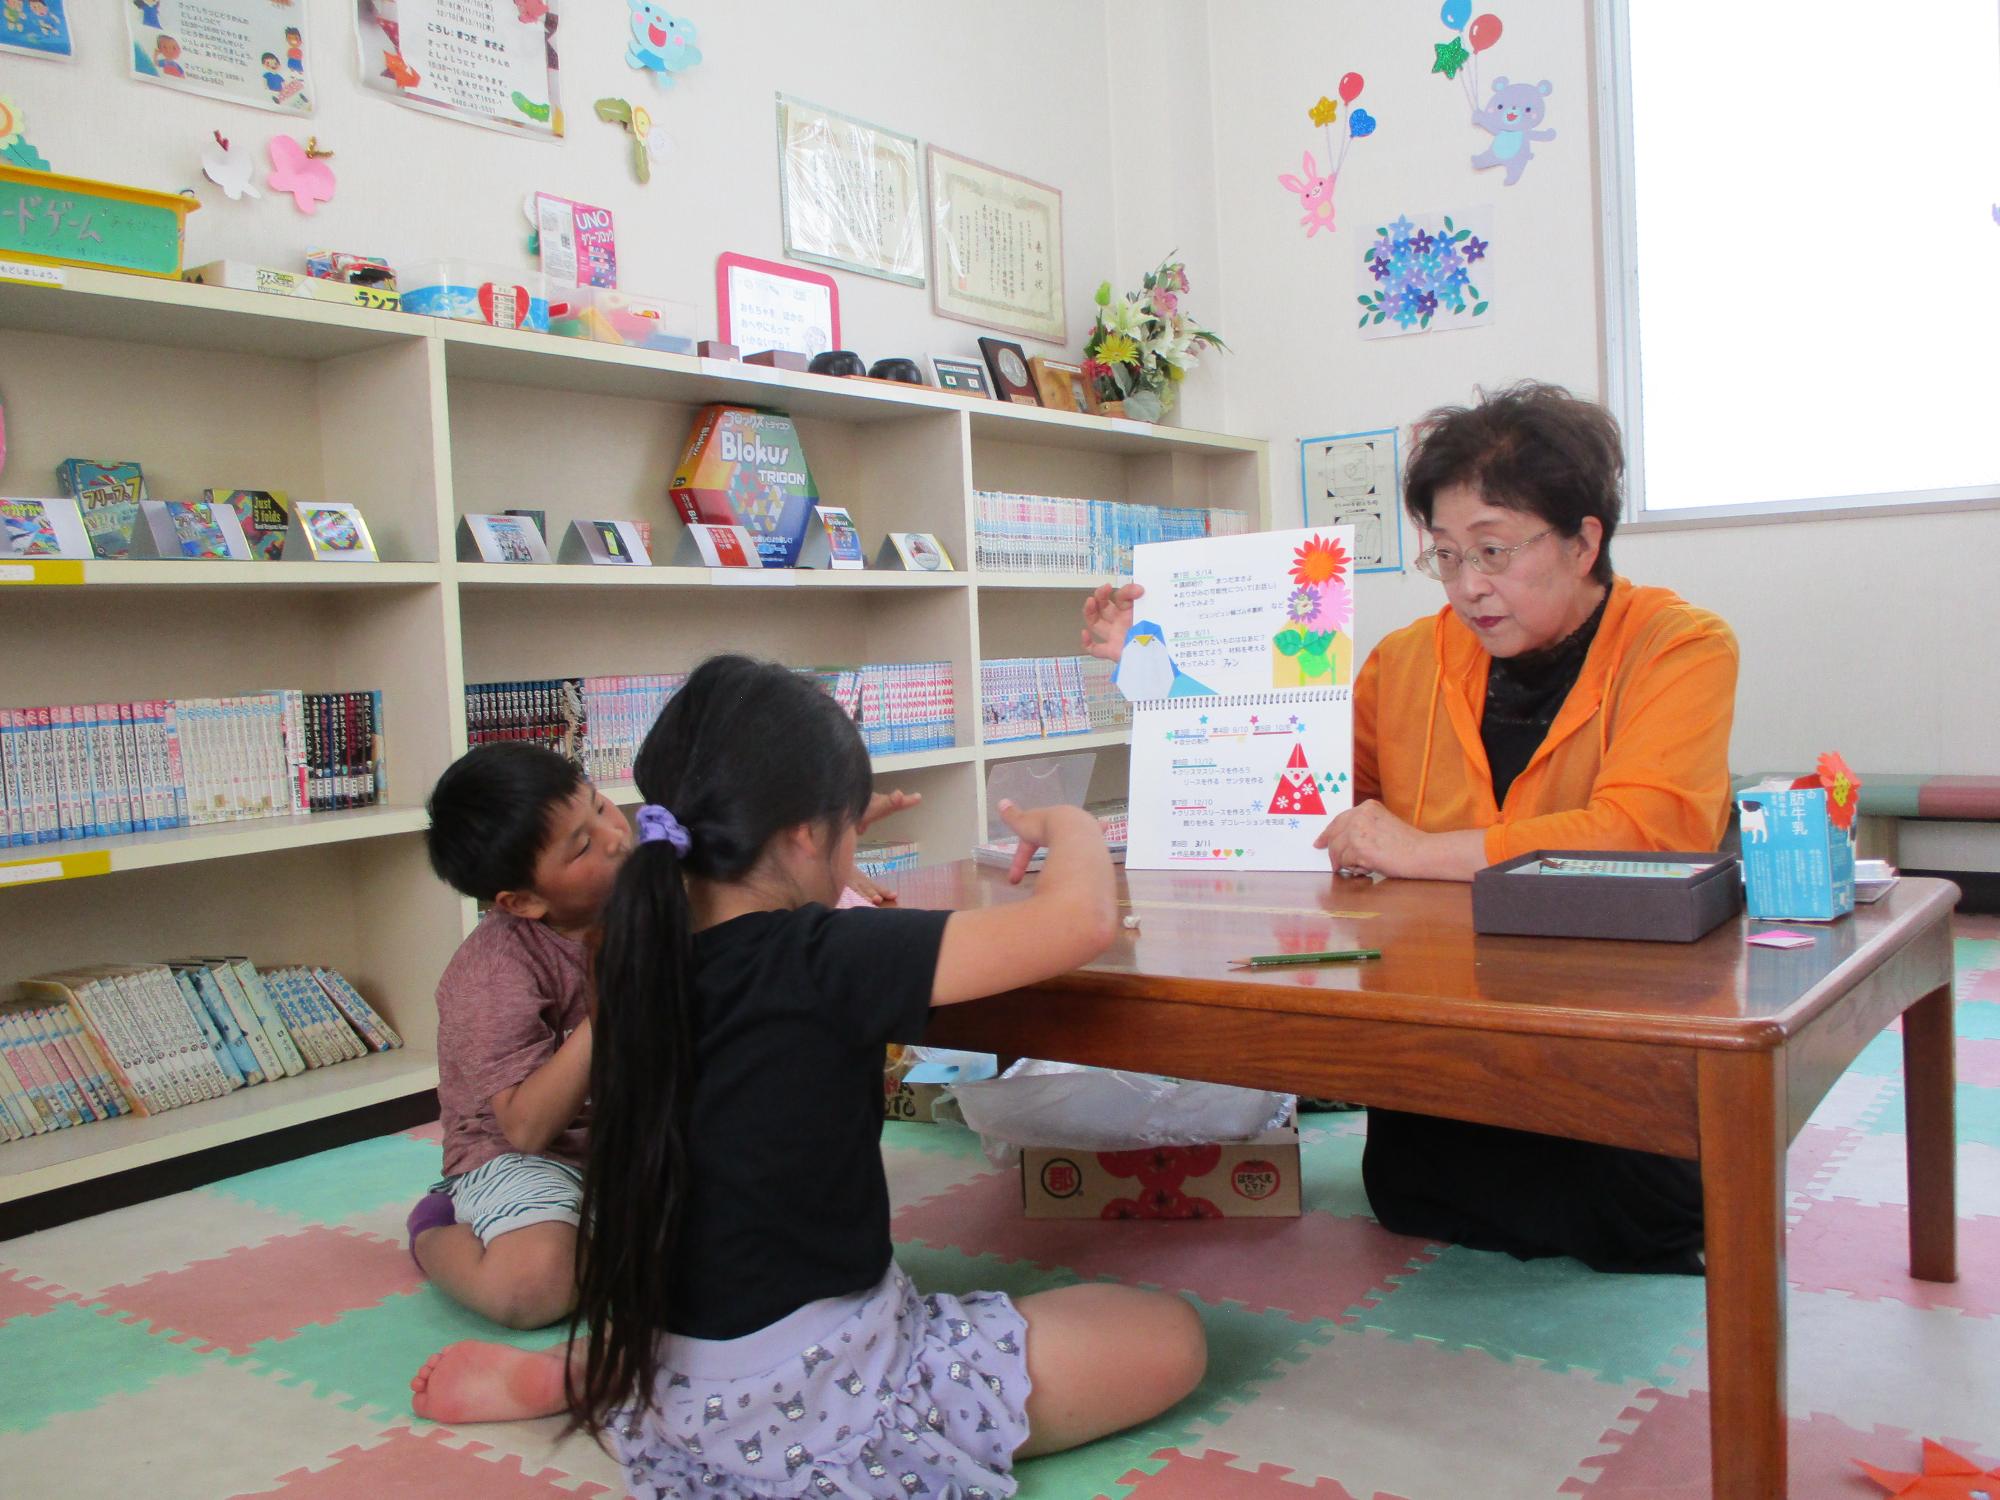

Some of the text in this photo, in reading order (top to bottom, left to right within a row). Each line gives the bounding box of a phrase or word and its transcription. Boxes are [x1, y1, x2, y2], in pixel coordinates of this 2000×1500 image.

[575, 210, 610, 231] UNO
[721, 431, 789, 465] Blokus
[757, 469, 806, 487] TRIGON
